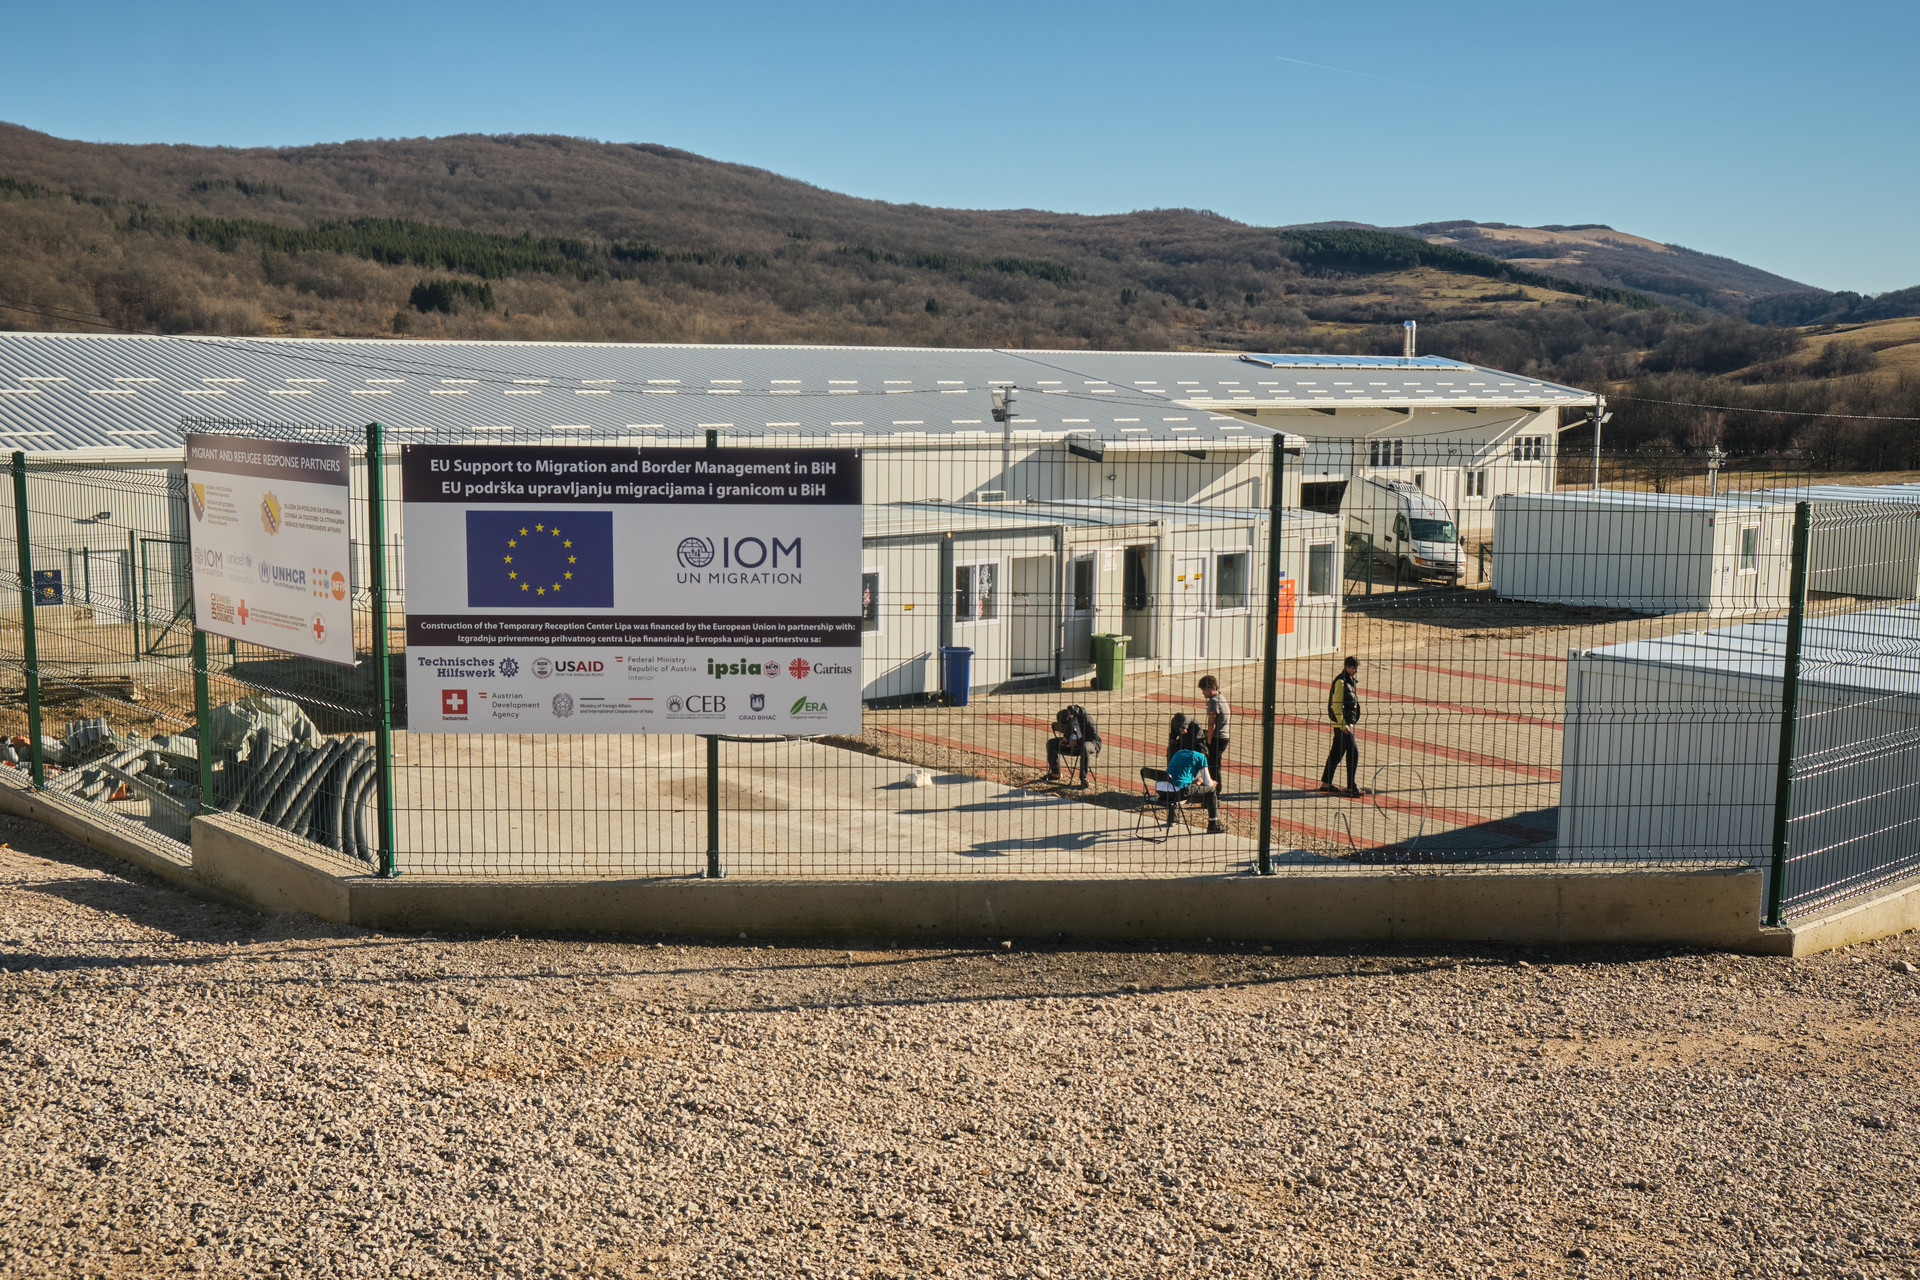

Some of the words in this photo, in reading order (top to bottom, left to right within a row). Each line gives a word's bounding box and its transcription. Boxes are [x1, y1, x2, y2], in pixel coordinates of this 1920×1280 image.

[191, 447, 218, 460] MIGRANT
[220, 450, 233, 461] AND
[233, 451, 261, 465] REFUGEE
[262, 454, 299, 469] RESPONSE
[300, 457, 340, 471] PARTNERS
[430, 459, 449, 471] EU
[453, 459, 513, 475] Support
[516, 461, 532, 472] to
[535, 459, 606, 476] Migration
[610, 459, 638, 473] and
[642, 460, 691, 473] Border
[694, 461, 790, 477] Management
[794, 461, 807, 474] in
[811, 461, 835, 474] BiH
[441, 481, 461, 493] EU
[465, 480, 524, 497] podrška
[528, 481, 611, 497] upravljanju
[615, 482, 705, 498] migracijama
[708, 482, 712, 495] i
[716, 482, 784, 499] granicom
[788, 486, 797, 495] u
[801, 483, 825, 496] BiH
[723, 536, 801, 568] IOM
[204, 549, 223, 569] IOM
[272, 566, 306, 584] UNHCR
[676, 572, 700, 583] UN
[708, 572, 801, 584] MIGRATION
[420, 621, 472, 629] Construction
[474, 621, 482, 629] of
[483, 621, 497, 629] the
[498, 622, 543, 631] Temporary
[544, 622, 584, 631] Reception
[614, 622, 631, 631] Lipa
[649, 622, 684, 630] financed
[686, 622, 696, 631] by
[697, 622, 711, 630] the
[712, 622, 750, 631] European
[752, 622, 776, 630] Union
[787, 623, 834, 631] partnership
[835, 622, 855, 630] with:
[457, 634, 496, 643] Izgradnju
[497, 634, 549, 643] privremenog
[551, 634, 595, 644] prihvatnog
[624, 635, 641, 643] Lipa
[642, 634, 684, 642] finansirala
[685, 635, 694, 644] je
[695, 635, 731, 644] Evropska
[733, 635, 753, 644] unija
[761, 636, 808, 644] partnerstvu
[417, 656, 494, 668] Technisches
[555, 660, 604, 672] USAID
[627, 656, 654, 665] Federal
[656, 656, 685, 665] Ministry
[437, 668, 495, 677] Hilfswerk
[627, 665, 658, 673] Republic
[660, 665, 668, 673] of
[670, 665, 696, 673] Austria
[707, 657, 761, 679] ipsia
[813, 662, 852, 674] Caritas
[491, 691, 522, 699] Austrian
[492, 701, 539, 709] Development
[685, 695, 726, 712] CEB
[805, 702, 828, 711] ERA
[492, 710, 519, 719] Agency
